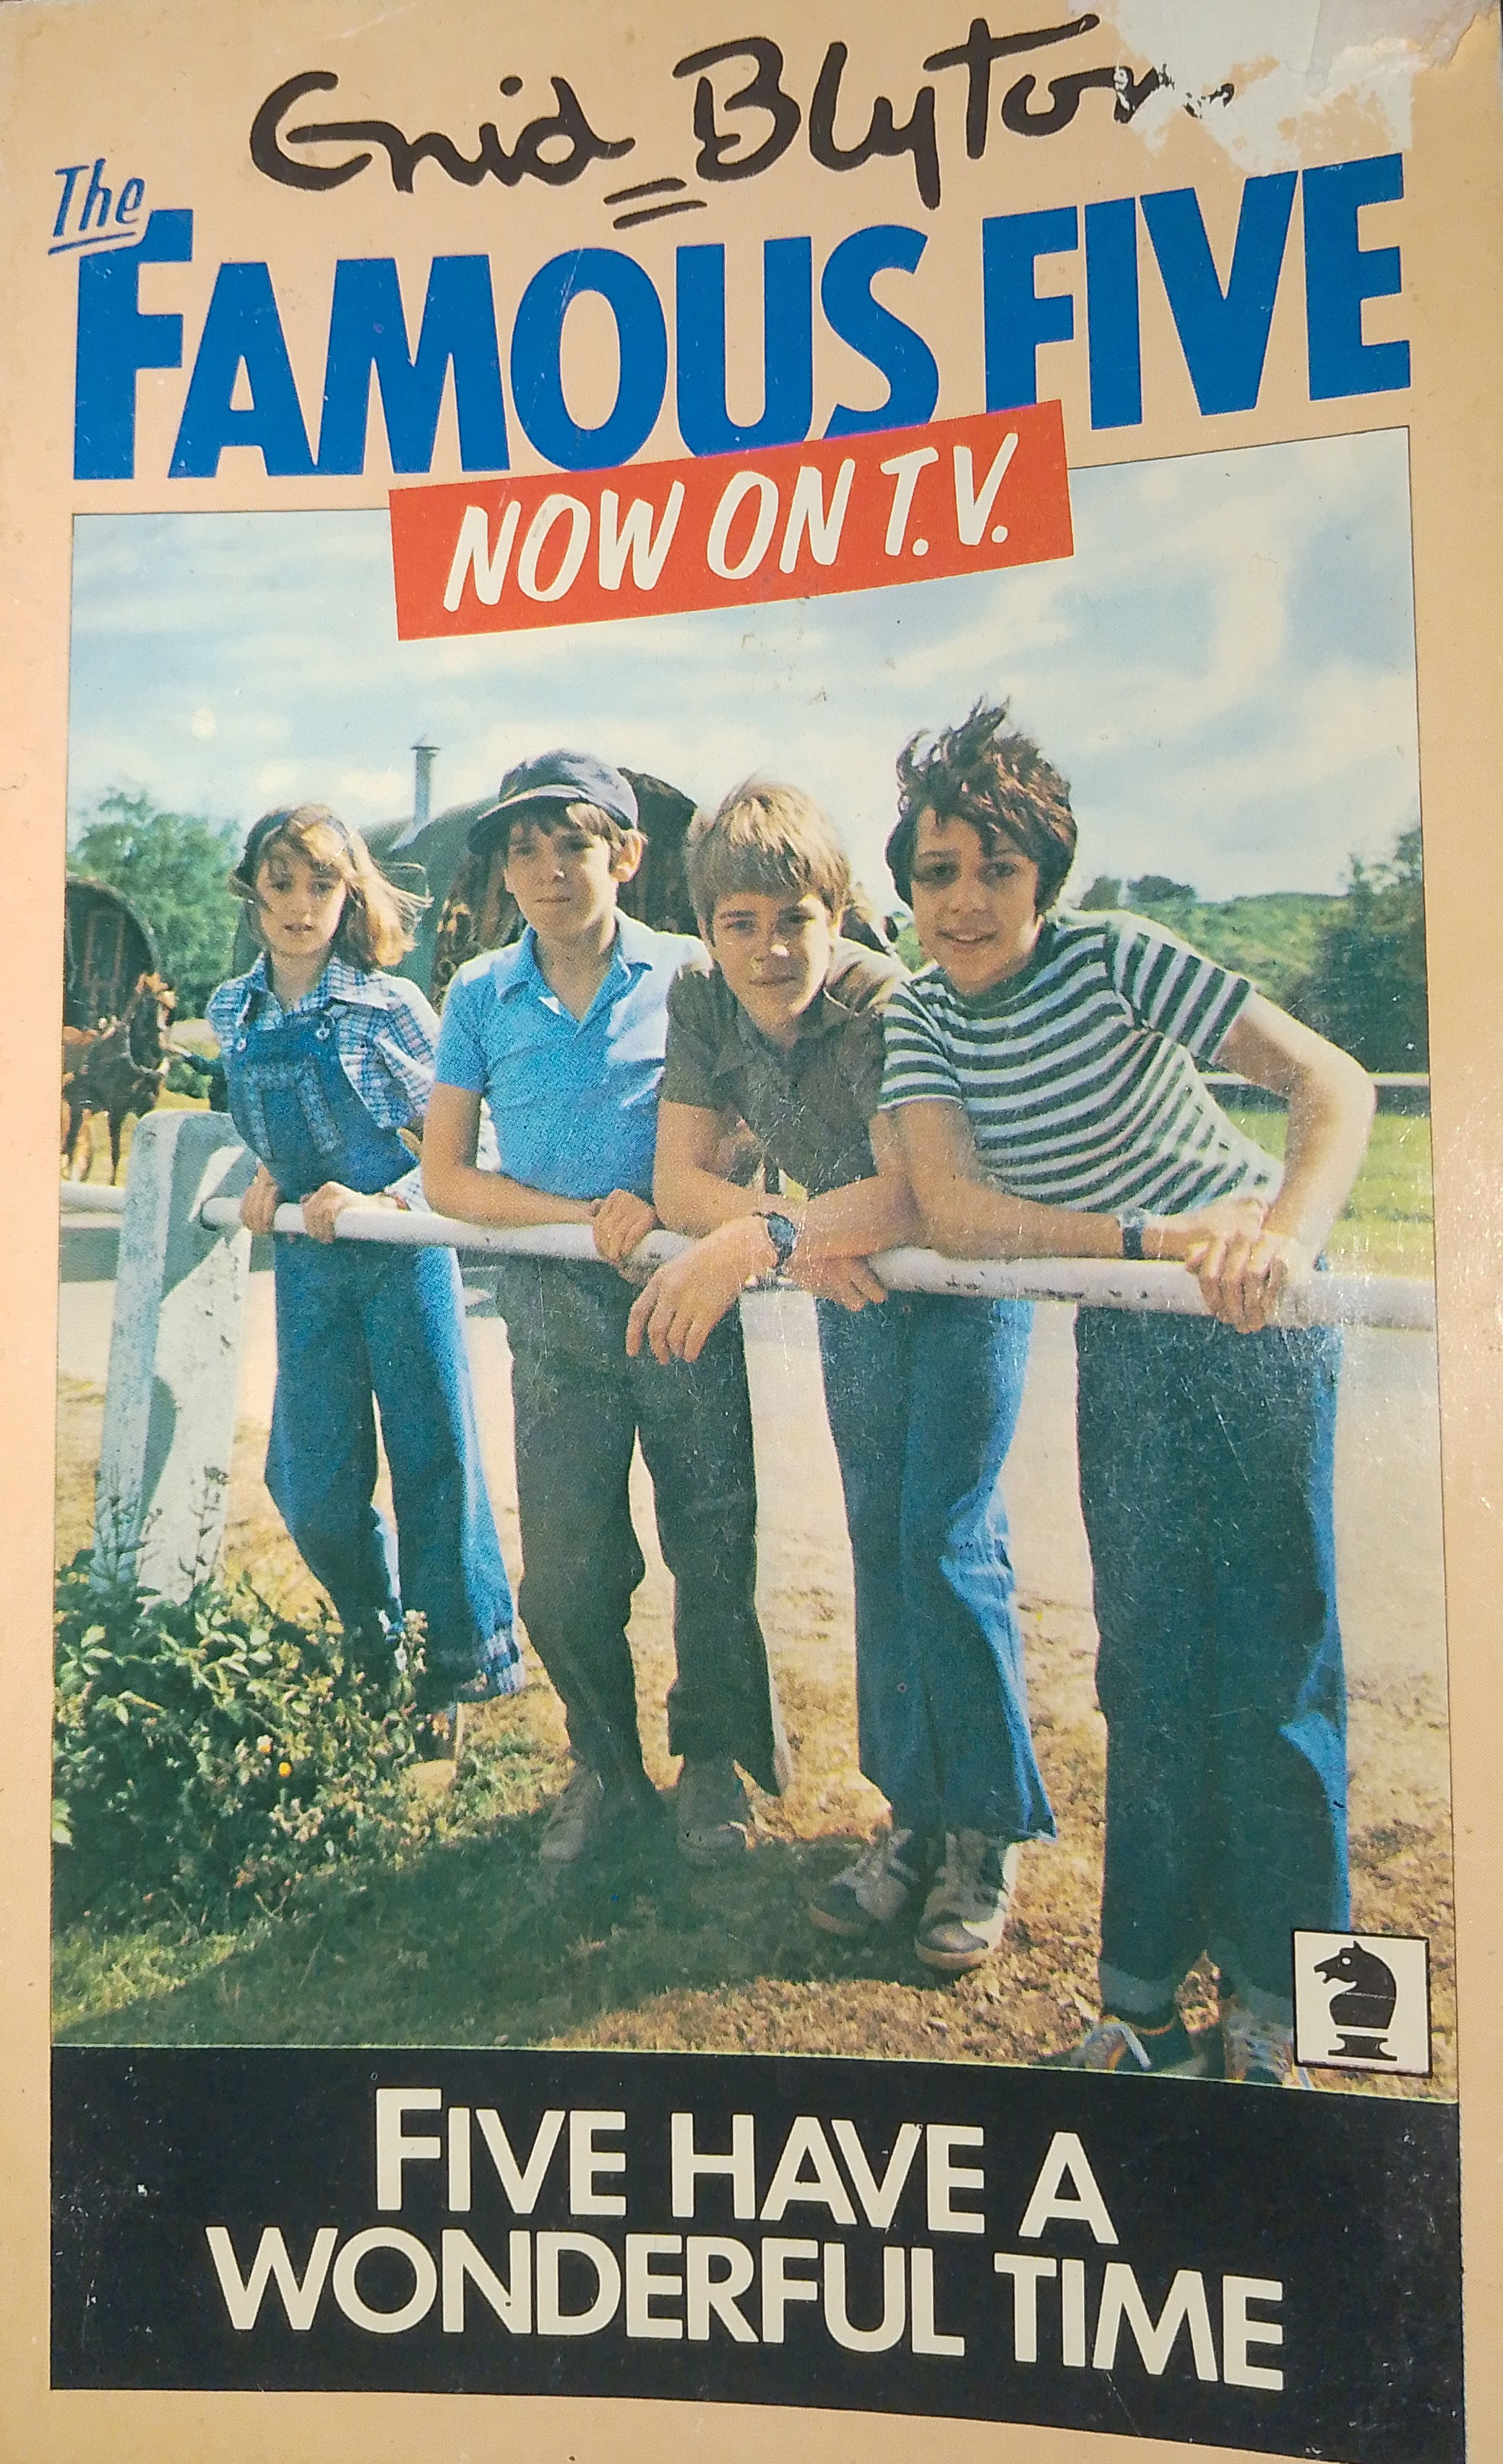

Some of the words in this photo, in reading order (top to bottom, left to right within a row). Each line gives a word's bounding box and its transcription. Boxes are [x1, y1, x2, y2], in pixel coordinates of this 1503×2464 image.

[53, 158, 145, 238] The
[250, 72, 635, 193] Enid
[73, 210, 939, 480] FAMOUS
[982, 153, 1411, 430] FIVE
[443, 481, 686, 612] NOW
[706, 459, 856, 580] ON
[879, 433, 1018, 557] T.V.
[375, 2087, 627, 2217] FIVE
[671, 2111, 985, 2235] HAVE
[1018, 2132, 1120, 2244] A
[205, 2225, 965, 2357] WONDERFUL
[994, 2251, 1285, 2391] TIME
